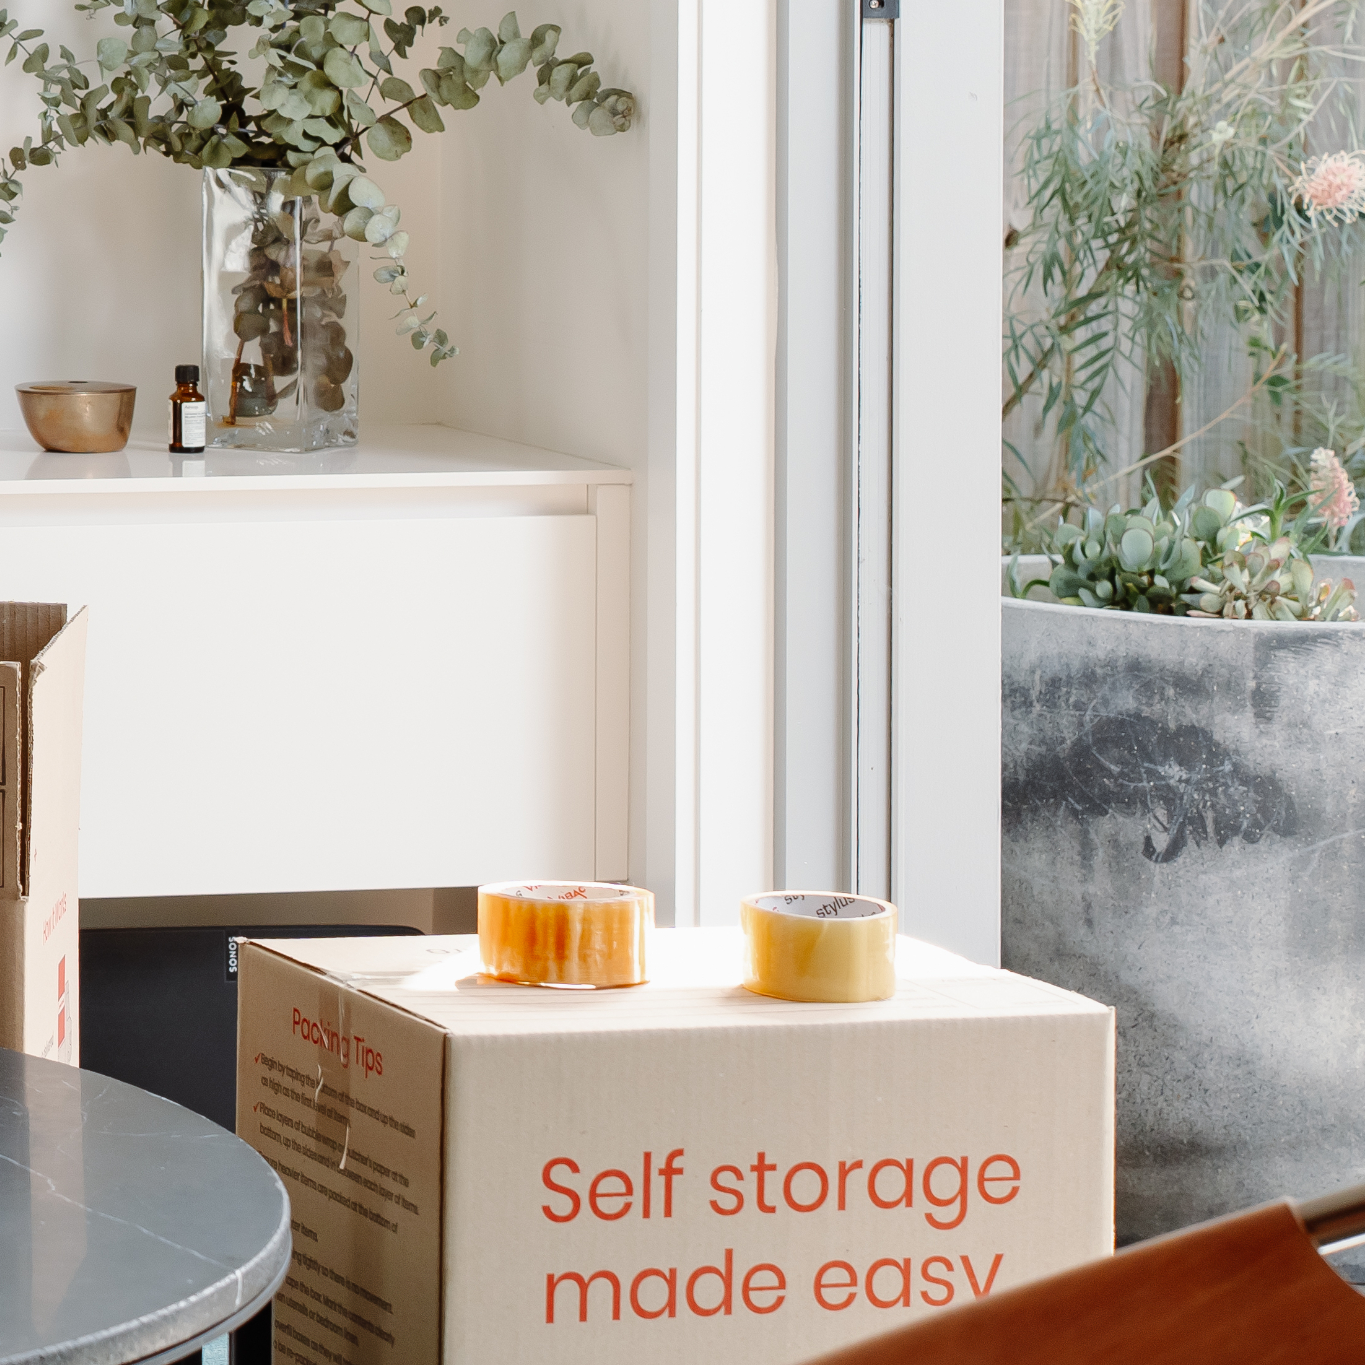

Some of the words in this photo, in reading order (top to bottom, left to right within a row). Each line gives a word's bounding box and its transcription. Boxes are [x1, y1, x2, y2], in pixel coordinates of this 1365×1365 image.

[228, 936, 238, 973] SONOS
[292, 1007, 350, 1069] Packing
[353, 1035, 383, 1079] Tips
[541, 1148, 685, 1223] Self
[709, 1152, 1021, 1230] storage
[545, 1248, 787, 1324] made
